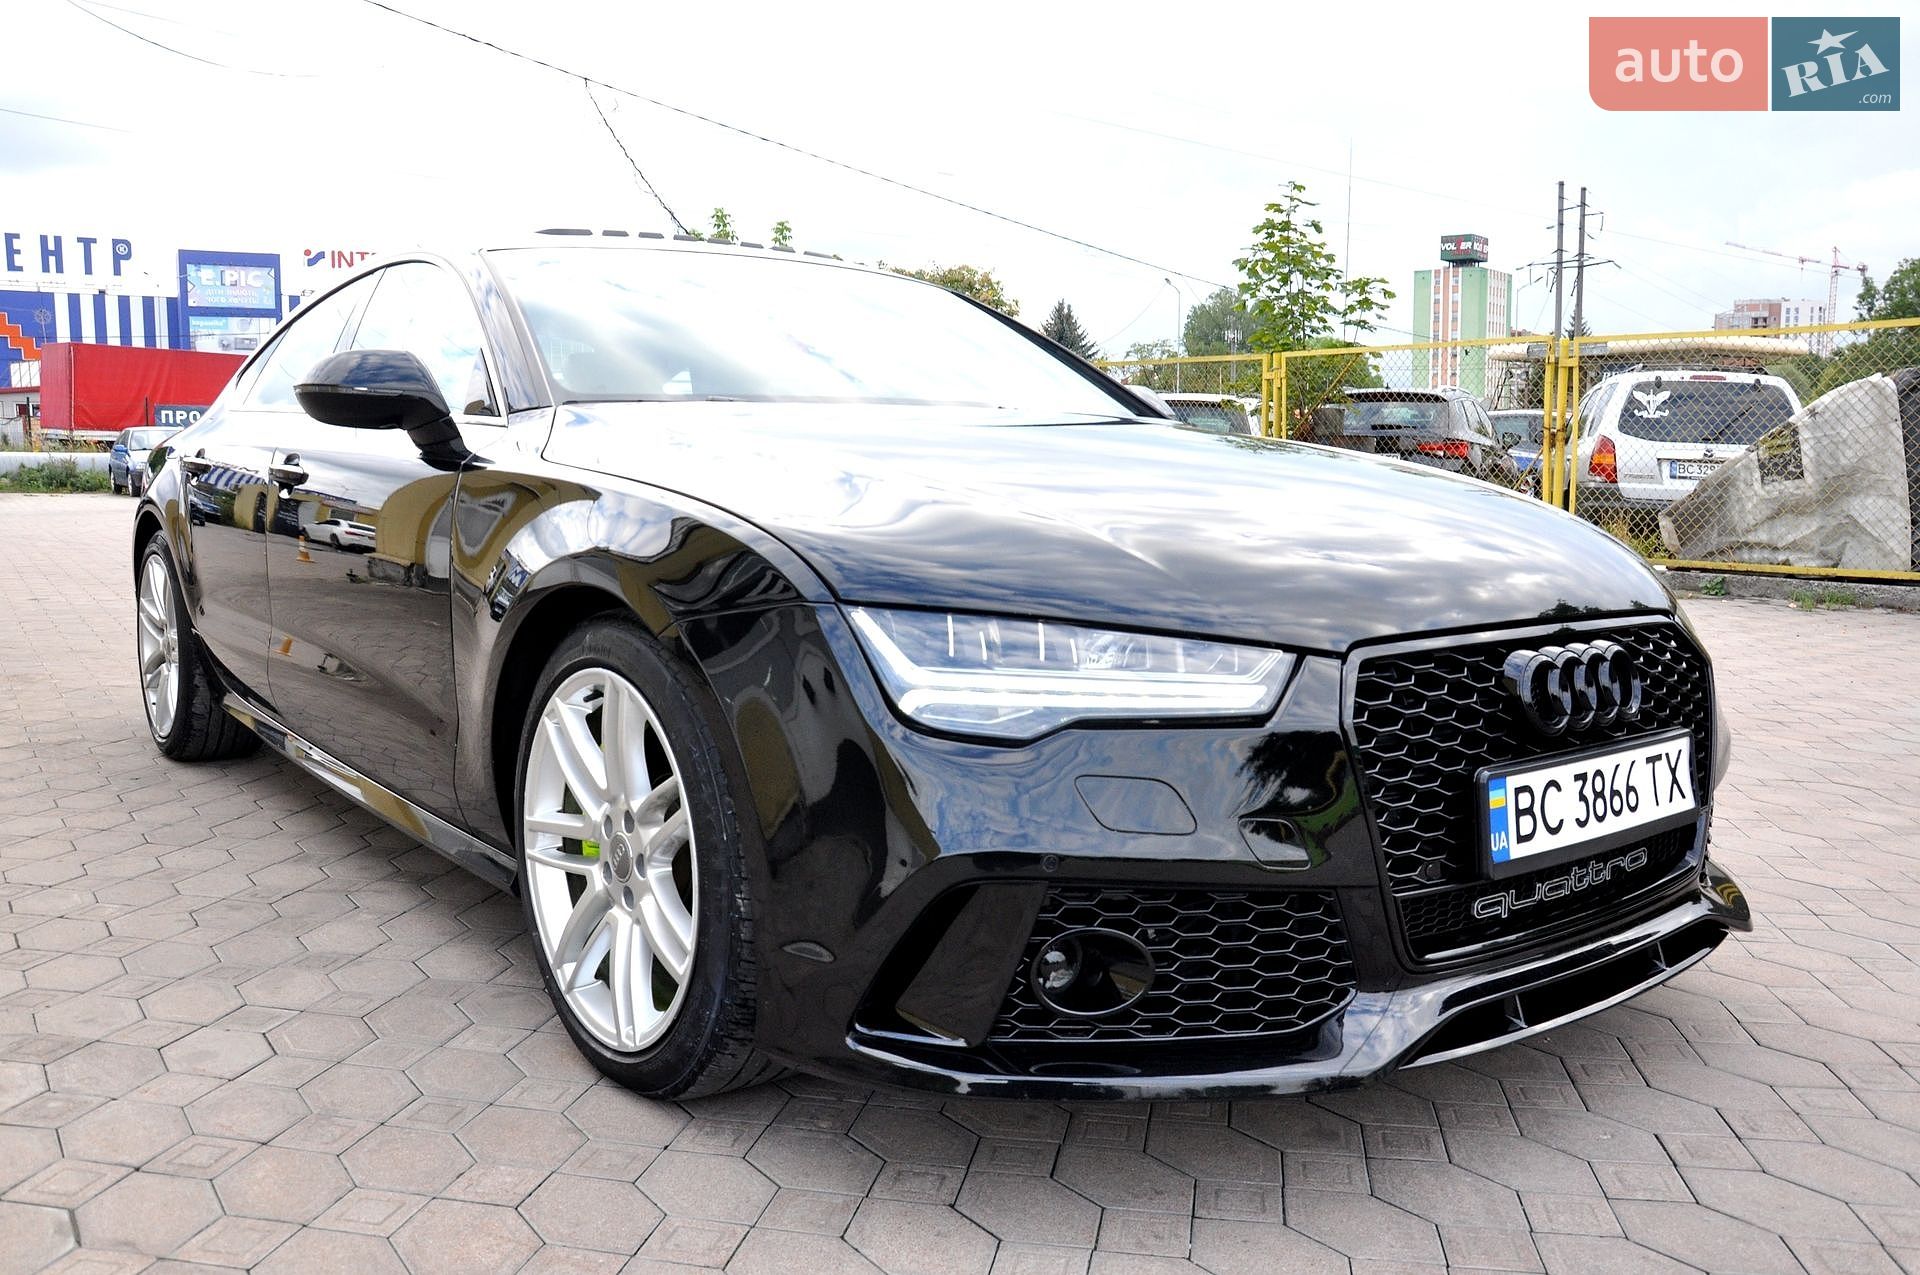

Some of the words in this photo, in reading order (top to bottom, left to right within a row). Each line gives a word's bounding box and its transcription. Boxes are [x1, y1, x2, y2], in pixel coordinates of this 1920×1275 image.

[4, 232, 132, 276] ЕНТР
[1678, 463, 1695, 475] BC
[1514, 780, 1564, 844] BC
[1573, 760, 1639, 828] 3866
[1645, 749, 1686, 807] TX
[1490, 831, 1508, 851] UA
[1474, 847, 1648, 919] quattro
